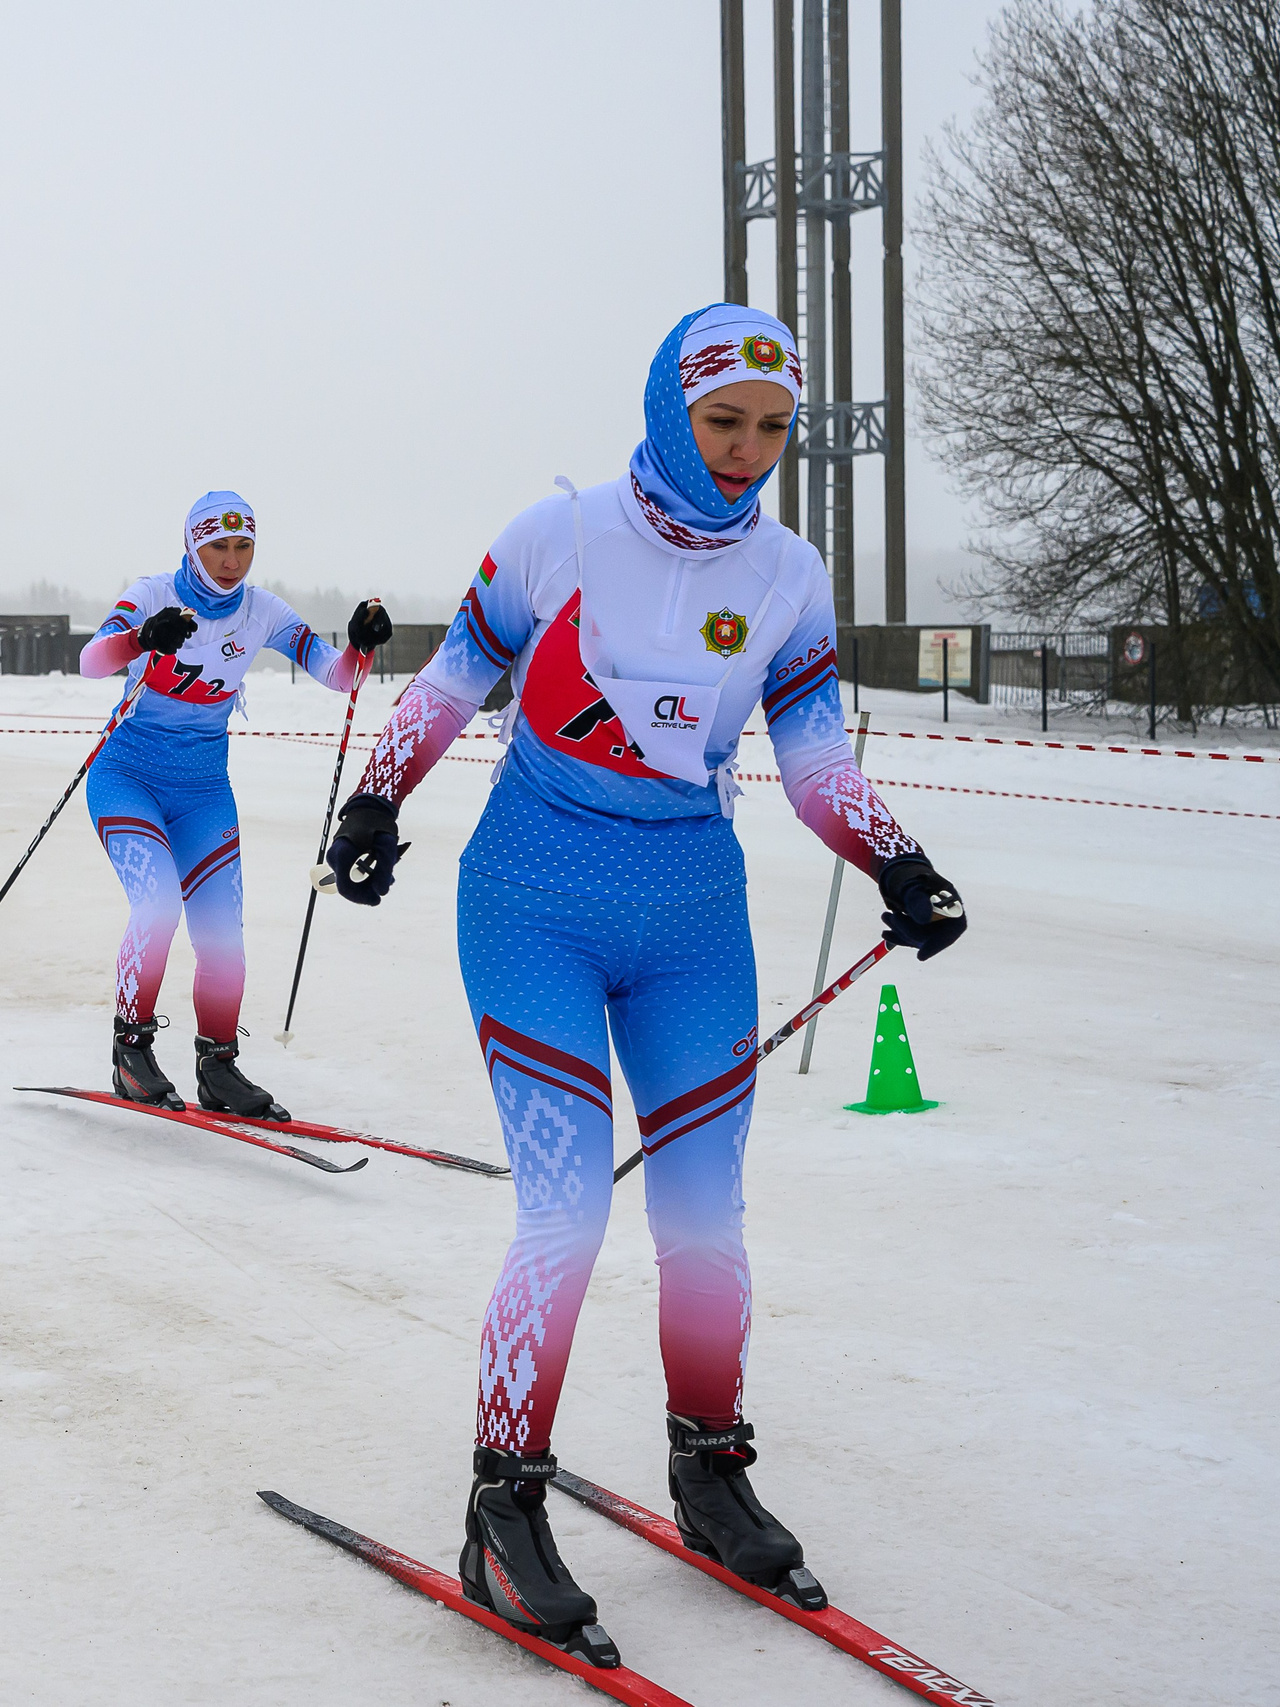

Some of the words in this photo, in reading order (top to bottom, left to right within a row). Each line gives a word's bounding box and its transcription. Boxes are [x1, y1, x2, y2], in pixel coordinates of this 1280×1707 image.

[289, 623, 304, 649] ORA
[774, 635, 830, 681] ORAZ
[685, 1434, 736, 1446] MARAX
[521, 1464, 556, 1473] MARA
[484, 1549, 521, 1607] MARAX
